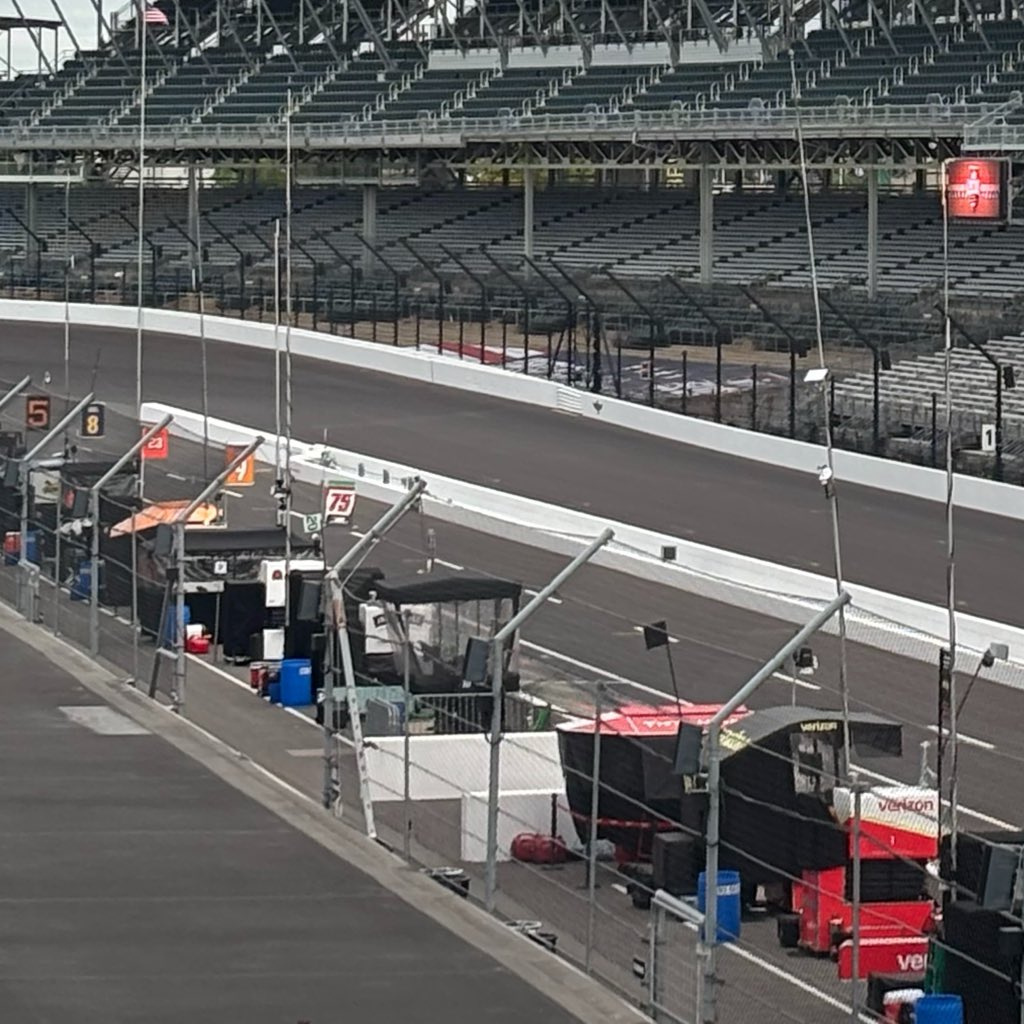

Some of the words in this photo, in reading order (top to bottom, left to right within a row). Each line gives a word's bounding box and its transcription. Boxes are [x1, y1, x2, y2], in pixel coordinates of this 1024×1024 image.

[28, 400, 48, 425] 5
[87, 415, 99, 434] 8
[985, 429, 993, 446] 1
[800, 721, 838, 732] verizon
[878, 799, 934, 812] verizon
